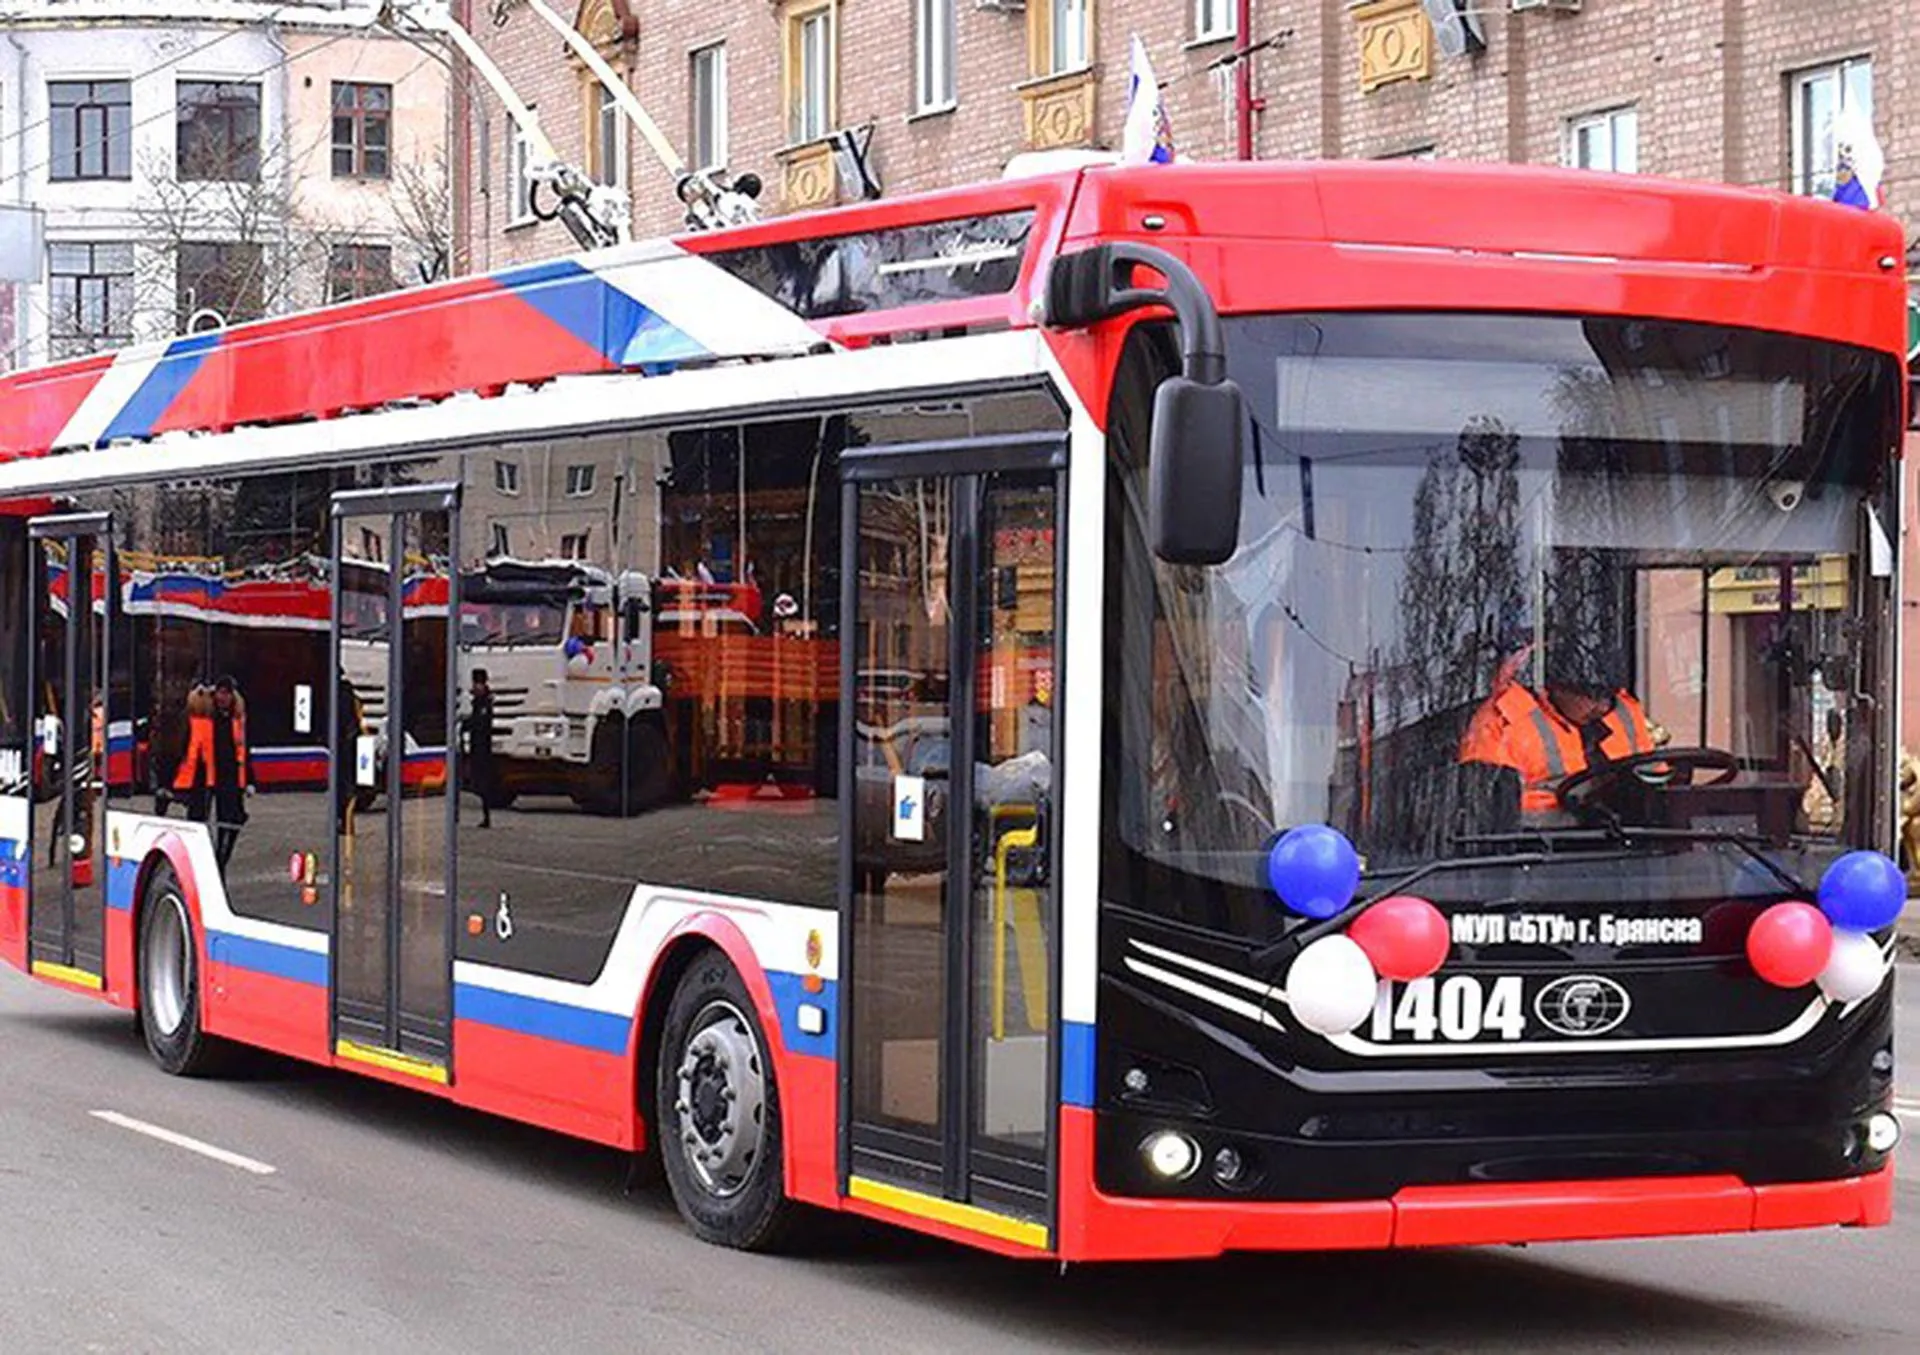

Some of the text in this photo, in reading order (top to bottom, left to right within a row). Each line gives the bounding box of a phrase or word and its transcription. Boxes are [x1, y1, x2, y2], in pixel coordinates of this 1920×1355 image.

[1452, 914, 1505, 943] МУП
[1579, 919, 1596, 943] г.
[1600, 913, 1702, 946] Брянска
